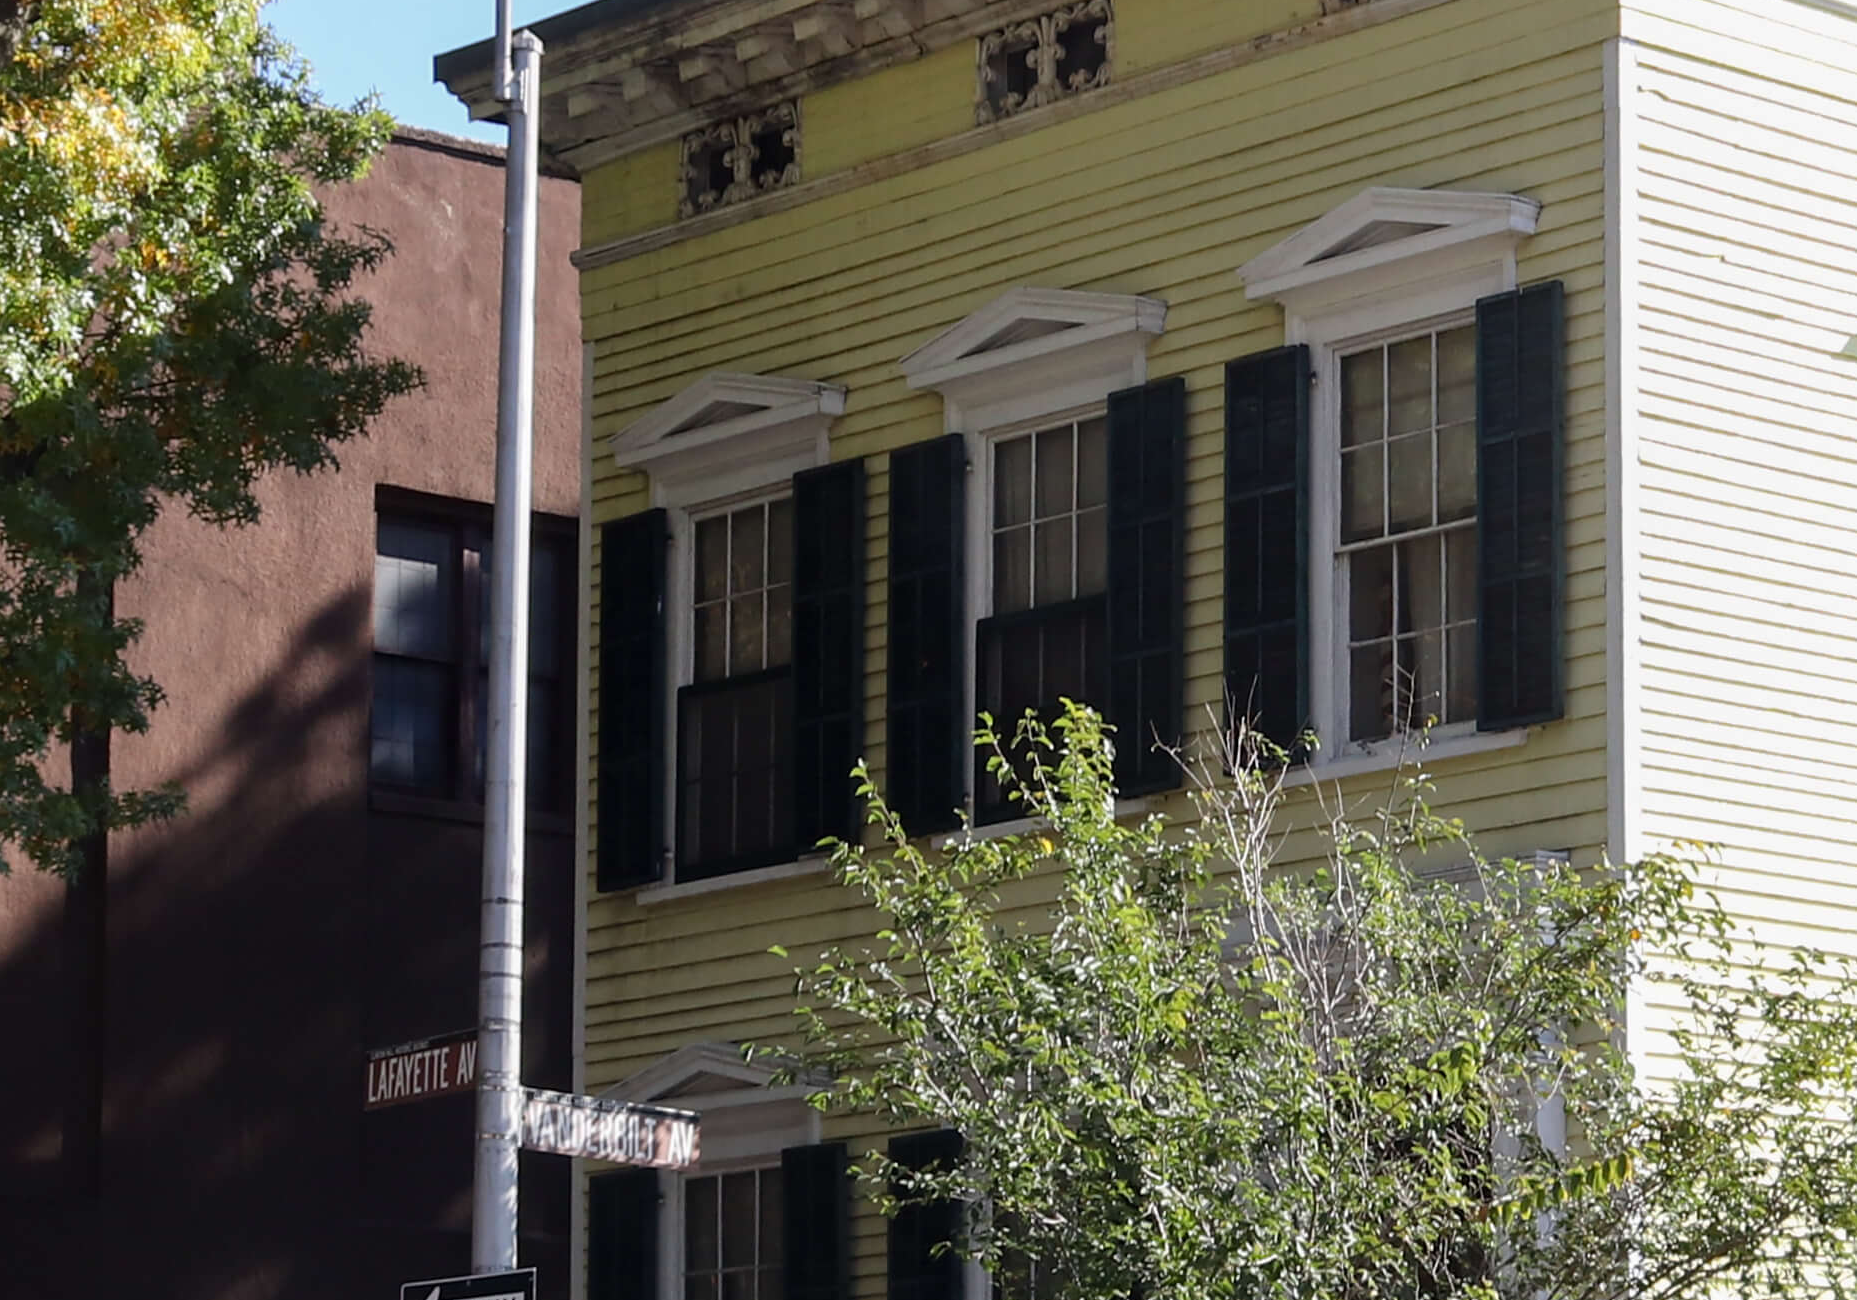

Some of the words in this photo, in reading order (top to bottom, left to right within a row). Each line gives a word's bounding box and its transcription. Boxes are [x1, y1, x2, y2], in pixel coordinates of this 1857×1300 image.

[367, 1046, 450, 1103] LAFAYETTE
[456, 1040, 478, 1086] AV
[528, 1100, 658, 1161] VANDERBILT
[667, 1121, 696, 1167] AV
